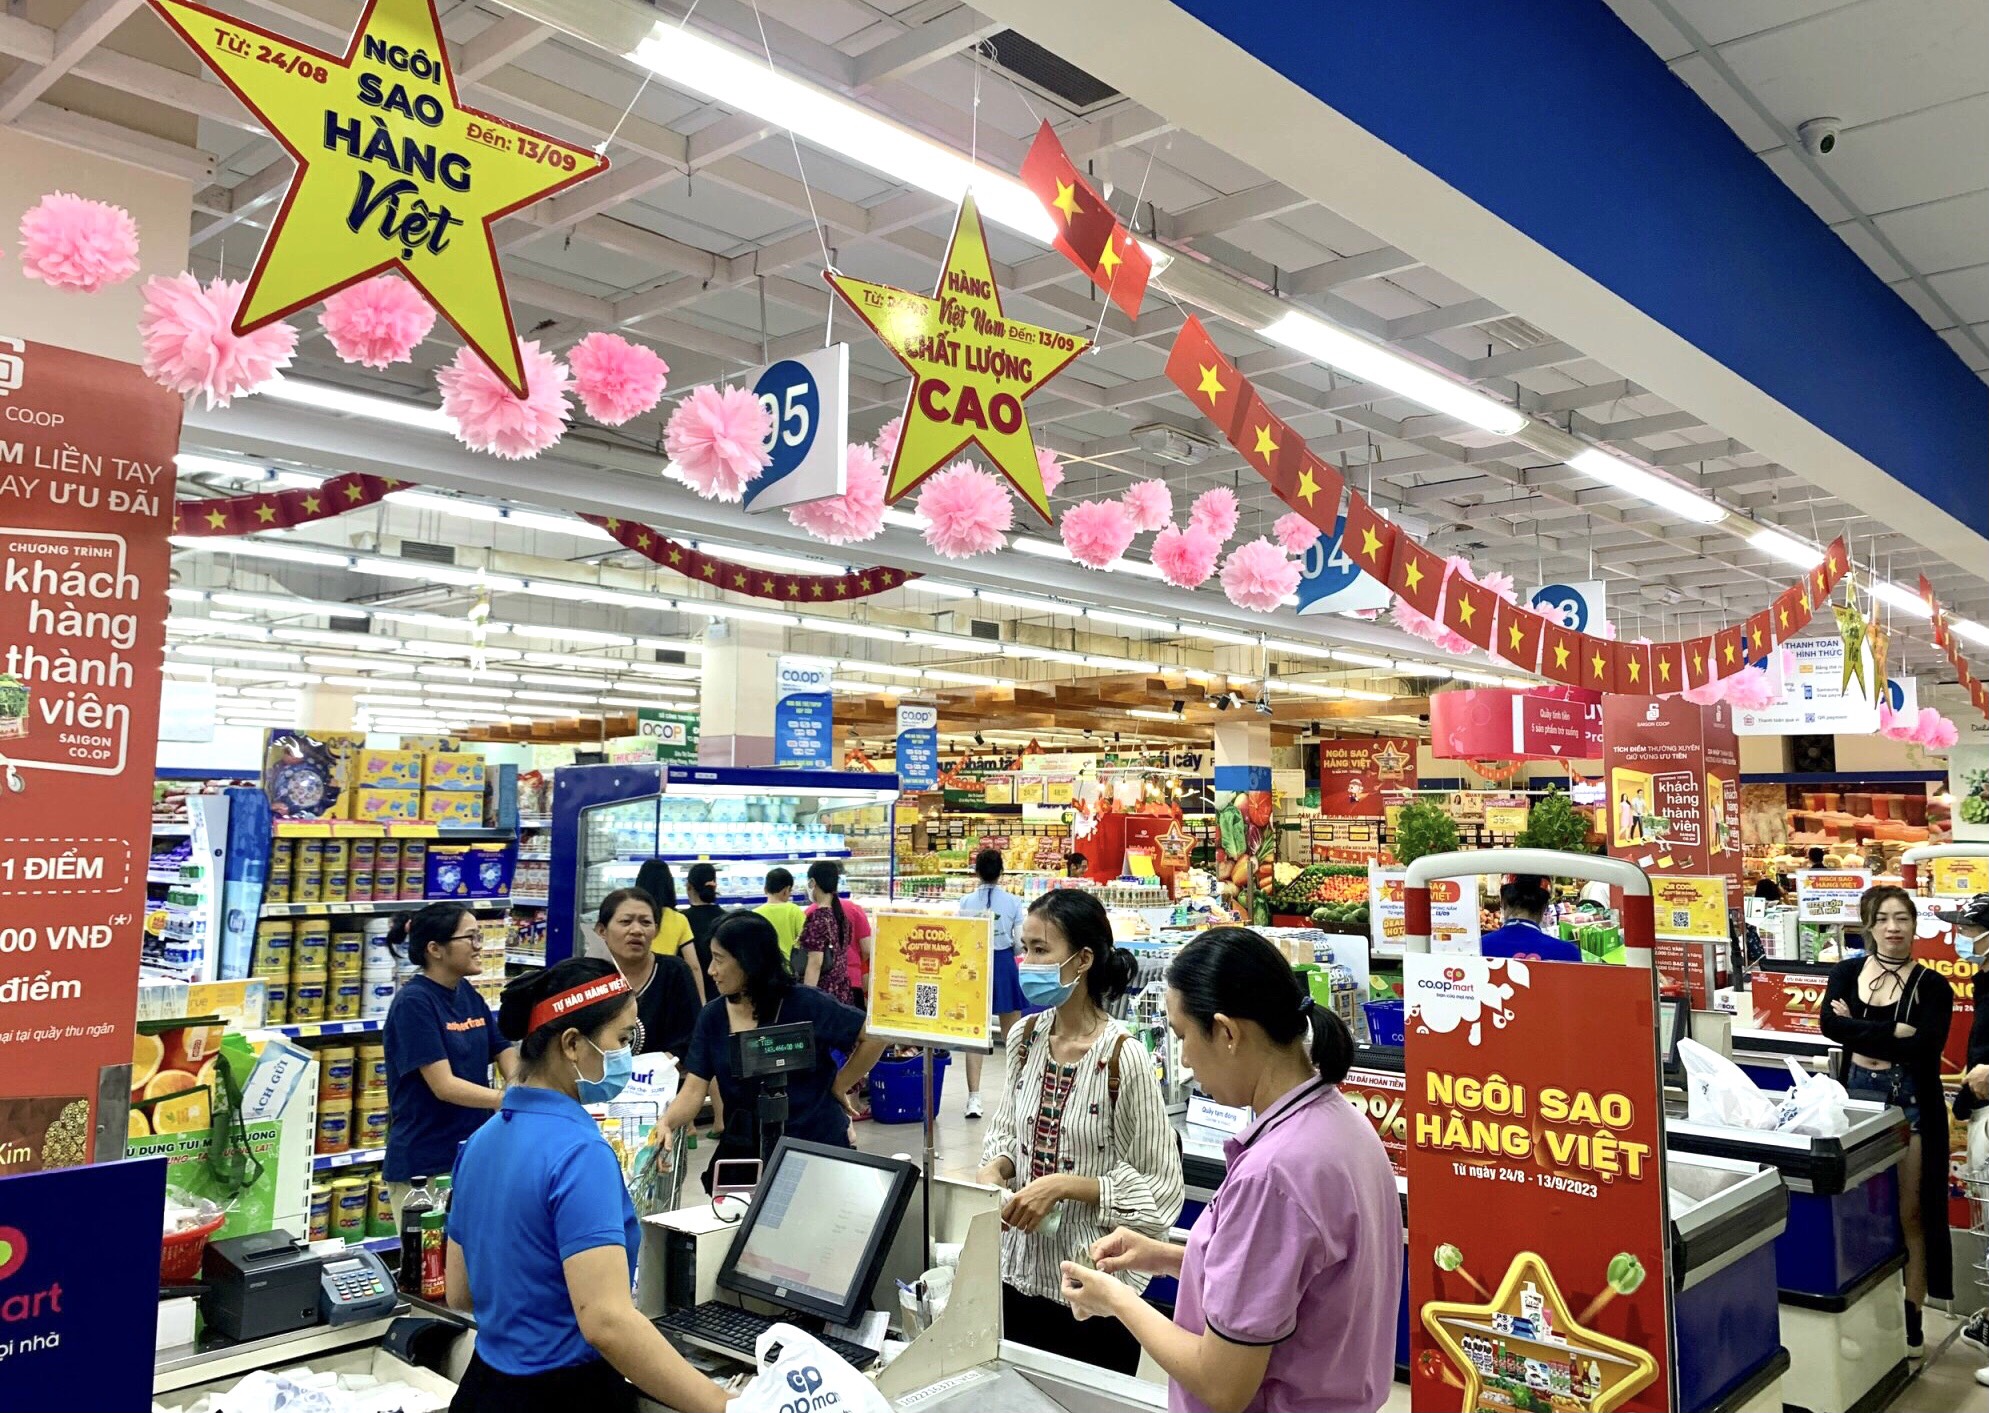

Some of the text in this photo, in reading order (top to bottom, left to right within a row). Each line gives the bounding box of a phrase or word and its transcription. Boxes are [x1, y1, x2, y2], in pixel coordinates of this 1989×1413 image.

[214, 27, 329, 85] Từ: 24/08
[362, 34, 442, 85] NGÔI
[356, 73, 445, 128] SAO
[321, 109, 472, 192] HÀNG
[465, 123, 577, 171] Đến: 13/09
[345, 169, 464, 260] Việt
[948, 269, 991, 300] HÀNG
[938, 296, 967, 334] Việt
[971, 306, 1006, 338] Nam
[1008, 326, 1075, 351] Đến: 13/09
[904, 331, 1033, 384] CHẤT LƯỢNG
[918, 378, 1023, 435] CAO
[35, 442, 102, 477] LIỀN
[112, 458, 163, 485] TAY
[50, 481, 99, 508] ƯU
[108, 489, 159, 517] ĐÃI
[8, 542, 113, 557] CHƯƠNG TRÌNH
[1303, 534, 1354, 580] 04
[4, 557, 140, 600] khách
[28, 599, 138, 650] hàng
[1785, 639, 1839, 650] THANH TOÁN
[1818, 648, 1842, 657] THỨC
[5, 644, 134, 688] thành
[39, 691, 130, 729] viên
[1540, 708, 1552, 719] Quầy
[59, 733, 112, 747] SAIGON
[642, 722, 682, 738] OCOP
[69, 747, 111, 760] CO.OP
[1173, 752, 1202, 771] cây
[1324, 759, 1371, 769] HÀNG VIỆT
[1326, 749, 1368, 758] NGÔI SAO
[1659, 781, 1698, 793] khách
[1666, 793, 1698, 807] hàng
[1662, 807, 1699, 819] thành
[1672, 822, 1699, 832] viên
[1, 847, 104, 880] 1 ĐIỂM
[911, 929, 952, 941] QR CODE
[1383, 920, 1405, 928] DEAL
[0, 970, 81, 1003] điểm
[552, 978, 626, 1013] TỰ HÀO HÀNG VIỆT
[16, 1029, 31, 1041] tại
[33, 1024, 62, 1044] quầy
[65, 1024, 84, 1037] thu
[631, 1069, 654, 1085] urf
[1202, 1106, 1214, 1116] Quầy
[1426, 1071, 1634, 1129] NGÔI SAO
[139, 1143, 175, 1156] DỤNG
[1416, 1110, 1651, 1183] HÀNG VIỆT
[1452, 1162, 1468, 1176] Từ
[1469, 1166, 1497, 1181] ngày
[1499, 1168, 1525, 1183] 24/8
[1537, 1174, 1598, 1198] 13/9/2023
[19, 1331, 60, 1353] nhà
